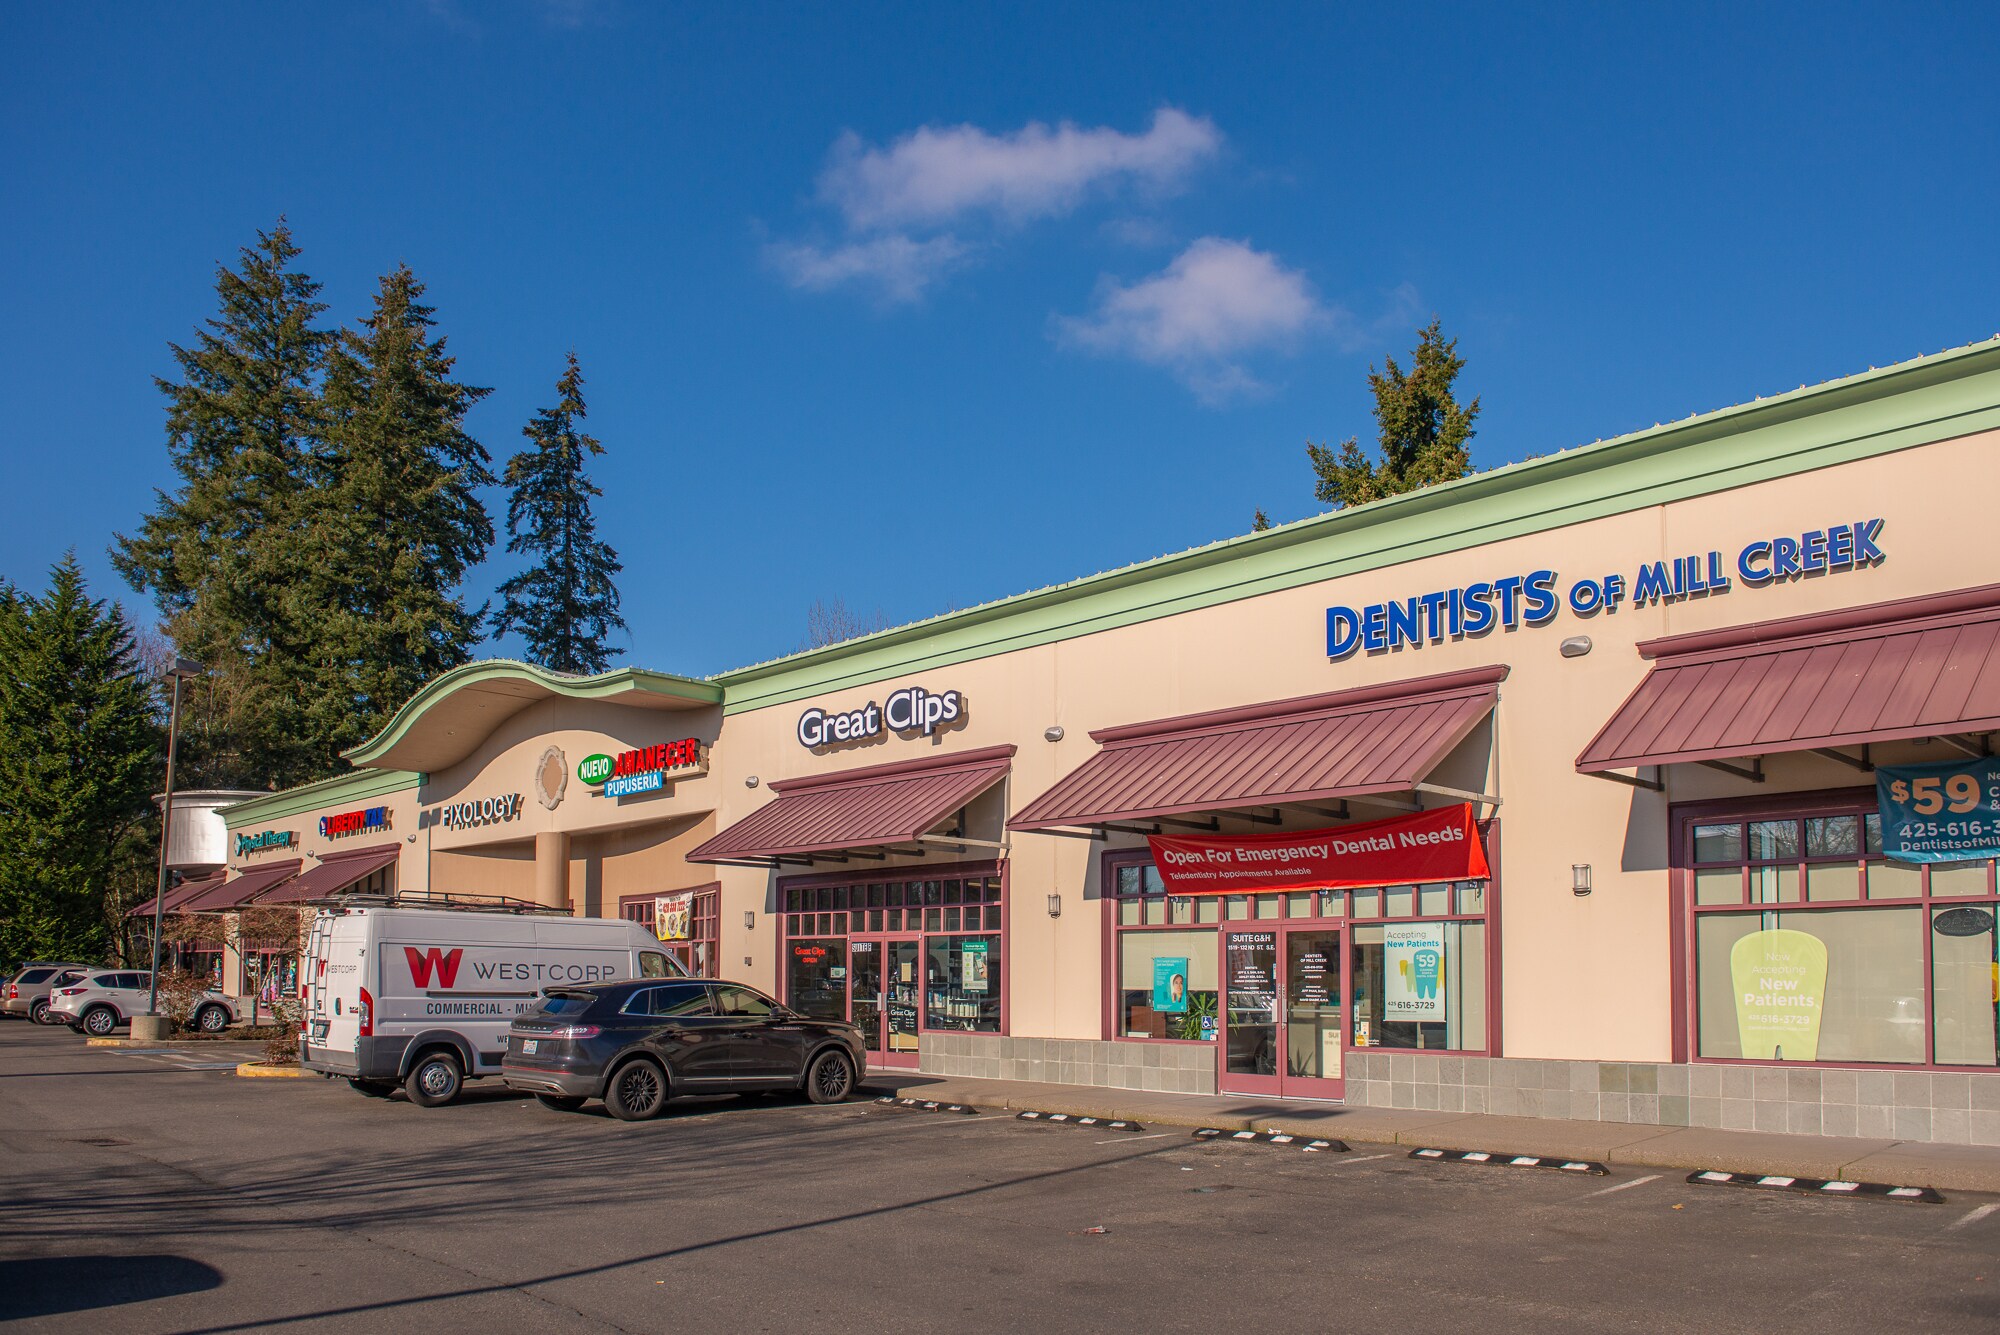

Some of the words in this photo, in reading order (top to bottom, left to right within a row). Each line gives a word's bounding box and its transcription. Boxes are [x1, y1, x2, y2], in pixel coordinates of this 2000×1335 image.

[1326, 570, 1558, 658] DENTISTS
[1569, 575, 1623, 612] OF
[1633, 550, 1730, 603] MILL
[1738, 518, 1885, 582] CREEK
[798, 704, 880, 747] Great
[886, 689, 960, 735] Clips
[615, 737, 697, 776] AMANECER
[581, 757, 609, 779] NUEVO
[607, 774, 660, 796] PUPUSERIA
[1891, 774, 1980, 815] $59
[442, 793, 517, 827] FIXOLOGY
[326, 810, 366, 835] LIBERTY
[366, 806, 386, 826] TAX
[241, 834, 264, 850] Physical
[265, 831, 290, 846] Therapy
[1163, 849, 1205, 867] Open
[1207, 847, 1232, 864] For
[1237, 844, 1329, 862] Emergency
[1332, 833, 1396, 855] Dental
[1399, 825, 1465, 848] Needs
[1169, 871, 1217, 881] Teledentistry
[1219, 869, 1273, 879] Appointments
[1275, 867, 1312, 877] Available
[1232, 934, 1253, 942] SUITE
[1254, 934, 1271, 942] G&H
[1386, 931, 1427, 939] Accepting
[1387, 940, 1404, 948] New
[1406, 940, 1439, 948] Patients
[1766, 952, 1791, 961] Now
[328, 964, 357, 974] ESTCORP
[473, 962, 616, 981] WESTCORP
[1752, 965, 1806, 976] Accepting
[1760, 977, 1799, 990] New
[1397, 1001, 1435, 1009] 616-3729
[1743, 993, 1815, 1007] Patients
[426, 1002, 503, 1015] COMMERCIAL
[1761, 1015, 1810, 1024] 616-3729
